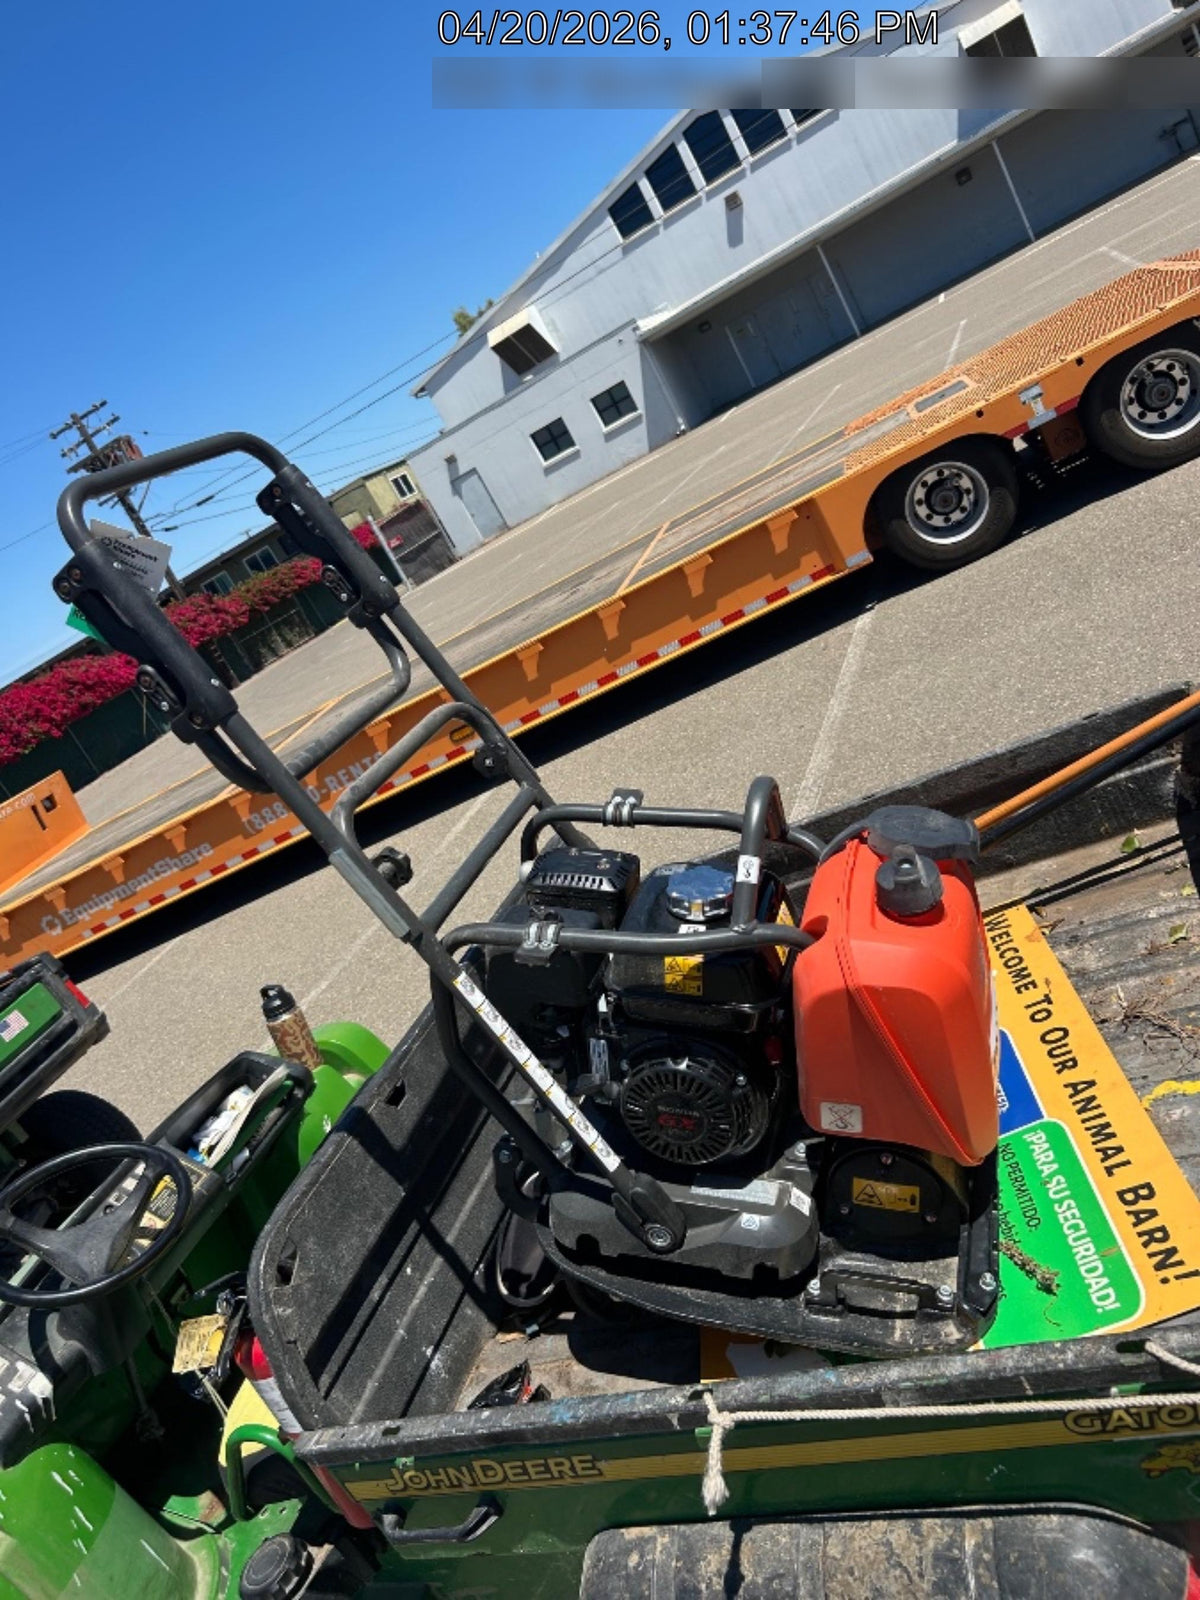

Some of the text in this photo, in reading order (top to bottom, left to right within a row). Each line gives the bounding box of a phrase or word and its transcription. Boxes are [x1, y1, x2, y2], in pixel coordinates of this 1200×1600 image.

[244, 802, 289, 834] (888
[58, 842, 214, 926] EquipmentShare
[985, 912, 1038, 994] WELCOME
[1040, 1026, 1078, 1074] OUR
[1063, 1079, 1132, 1178] ANIMAL
[1116, 1181, 1200, 1285] BARN!
[1008, 1160, 1042, 1233] PERMITIDO:
[1046, 1173, 1070, 1201] SU
[1055, 1197, 1121, 1313] SEGURIDAD!
[1064, 1405, 1200, 1434] GATO
[387, 1455, 601, 1493] JOHN DEERE
